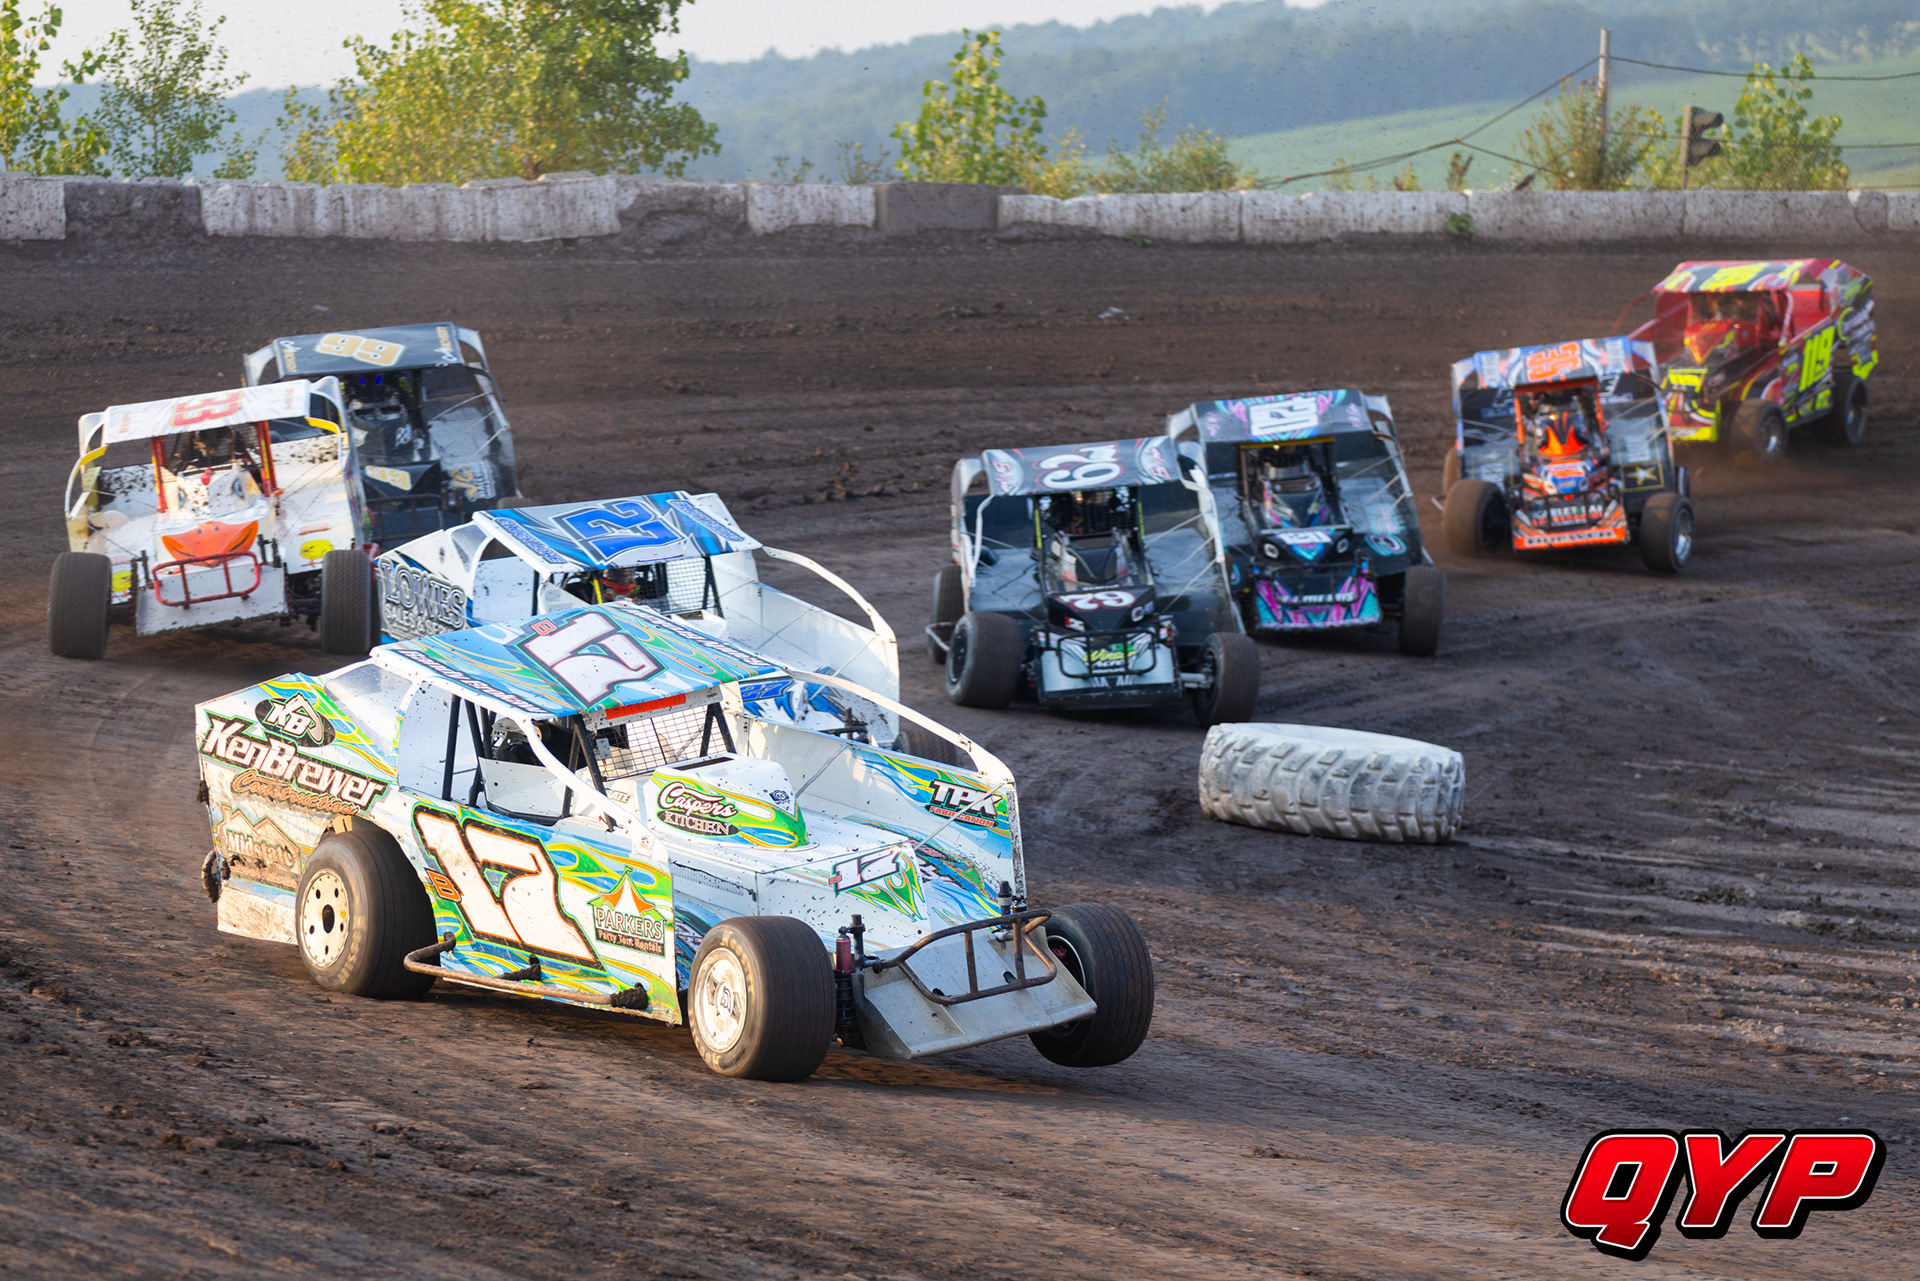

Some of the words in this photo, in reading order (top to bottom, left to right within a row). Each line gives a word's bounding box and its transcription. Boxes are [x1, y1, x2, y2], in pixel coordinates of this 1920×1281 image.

[317, 333, 405, 366] 99
[172, 391, 243, 427] 33
[381, 562, 465, 628] LOWES
[384, 603, 416, 629] SALES
[525, 612, 659, 702] 17
[266, 700, 313, 737] KB
[232, 768, 360, 816] Construction
[659, 782, 738, 817] Caspers
[933, 780, 1003, 816] TPK
[663, 811, 731, 836] KITCHEN
[929, 805, 995, 828] FABRCATION
[416, 811, 598, 964] 17
[427, 869, 463, 903] B
[596, 908, 663, 941] PARKERS
[598, 929, 617, 944] Party
[618, 933, 634, 947] Tent
[634, 939, 663, 953] Rentals
